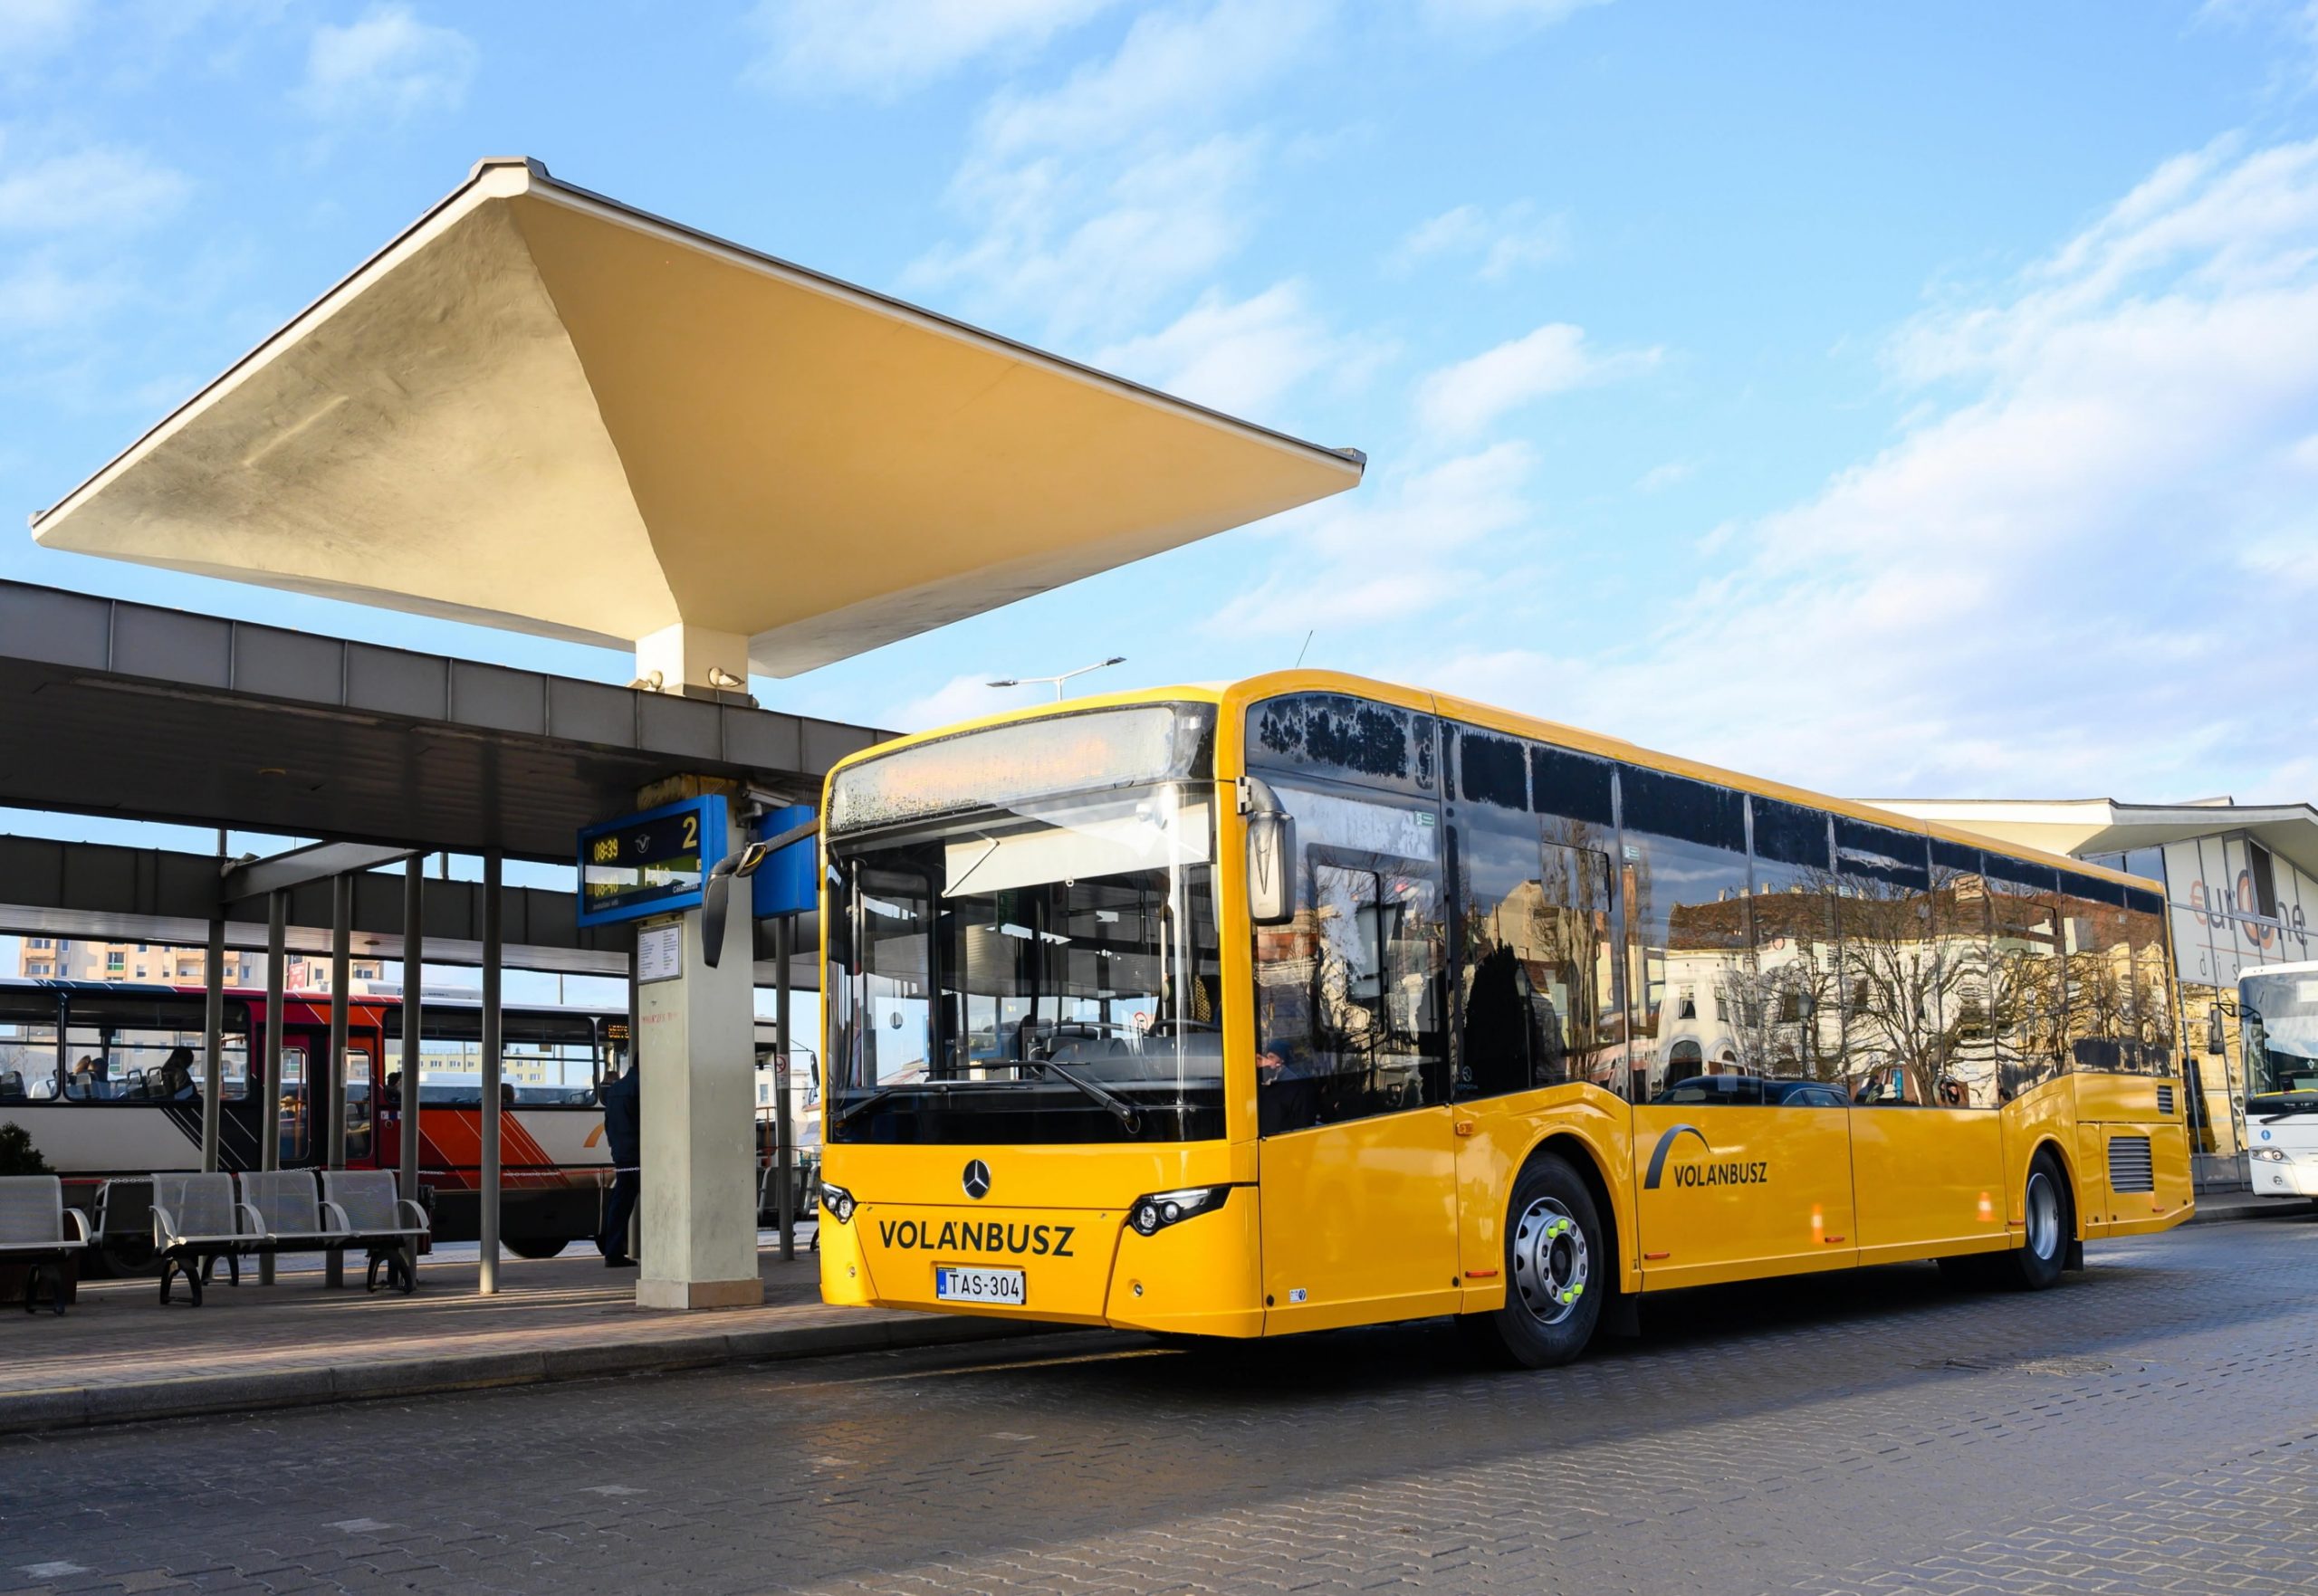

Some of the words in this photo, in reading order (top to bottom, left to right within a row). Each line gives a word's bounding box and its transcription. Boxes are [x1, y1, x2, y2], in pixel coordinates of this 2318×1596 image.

[682, 817, 697, 849] 2
[594, 838, 618, 862] 08:39
[1674, 1162, 1767, 1188] VOLÁNBUSZ
[879, 1220, 1076, 1257] VOLÁNBUSZ
[949, 1274, 1020, 1297] TAS-304
